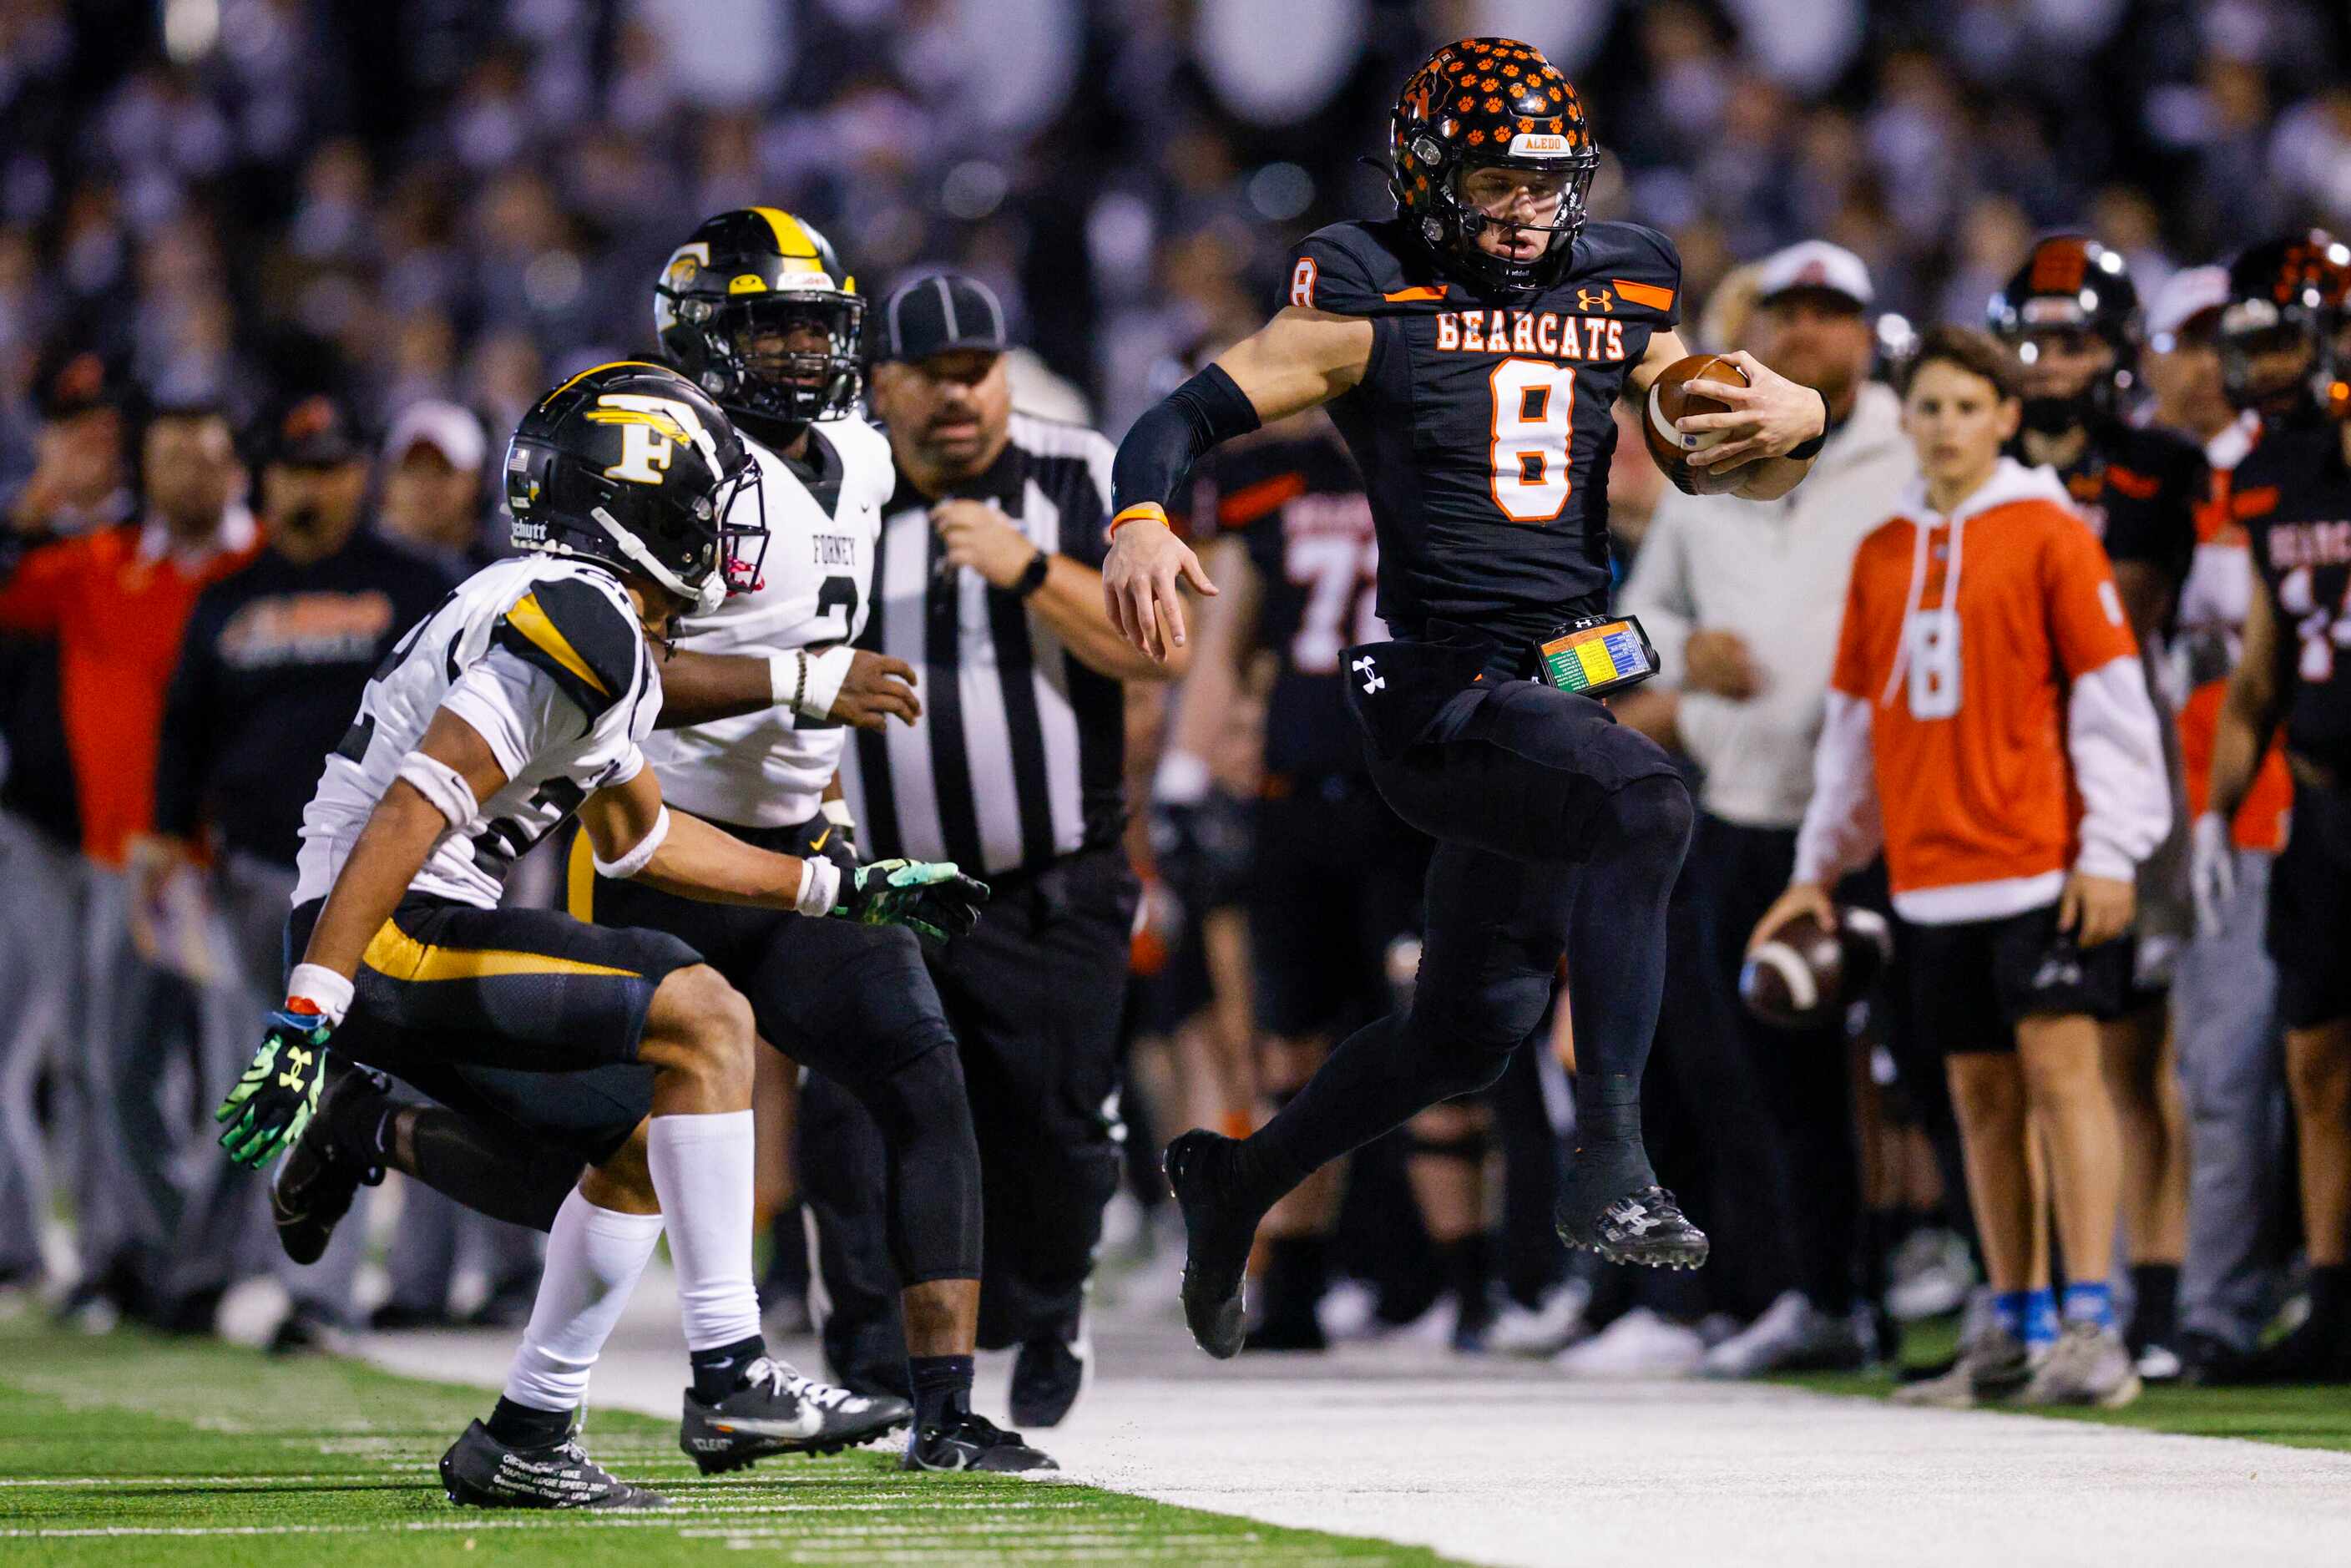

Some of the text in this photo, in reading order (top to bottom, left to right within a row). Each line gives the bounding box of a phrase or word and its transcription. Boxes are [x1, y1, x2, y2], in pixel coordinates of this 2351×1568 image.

[1524, 138, 1561, 149] ALEDO
[1436, 310, 1625, 361] BEARCATS
[597, 394, 704, 485] F
[1489, 356, 1576, 521] 8
[812, 534, 855, 566] FORNEY
[1904, 607, 1960, 721] 8
